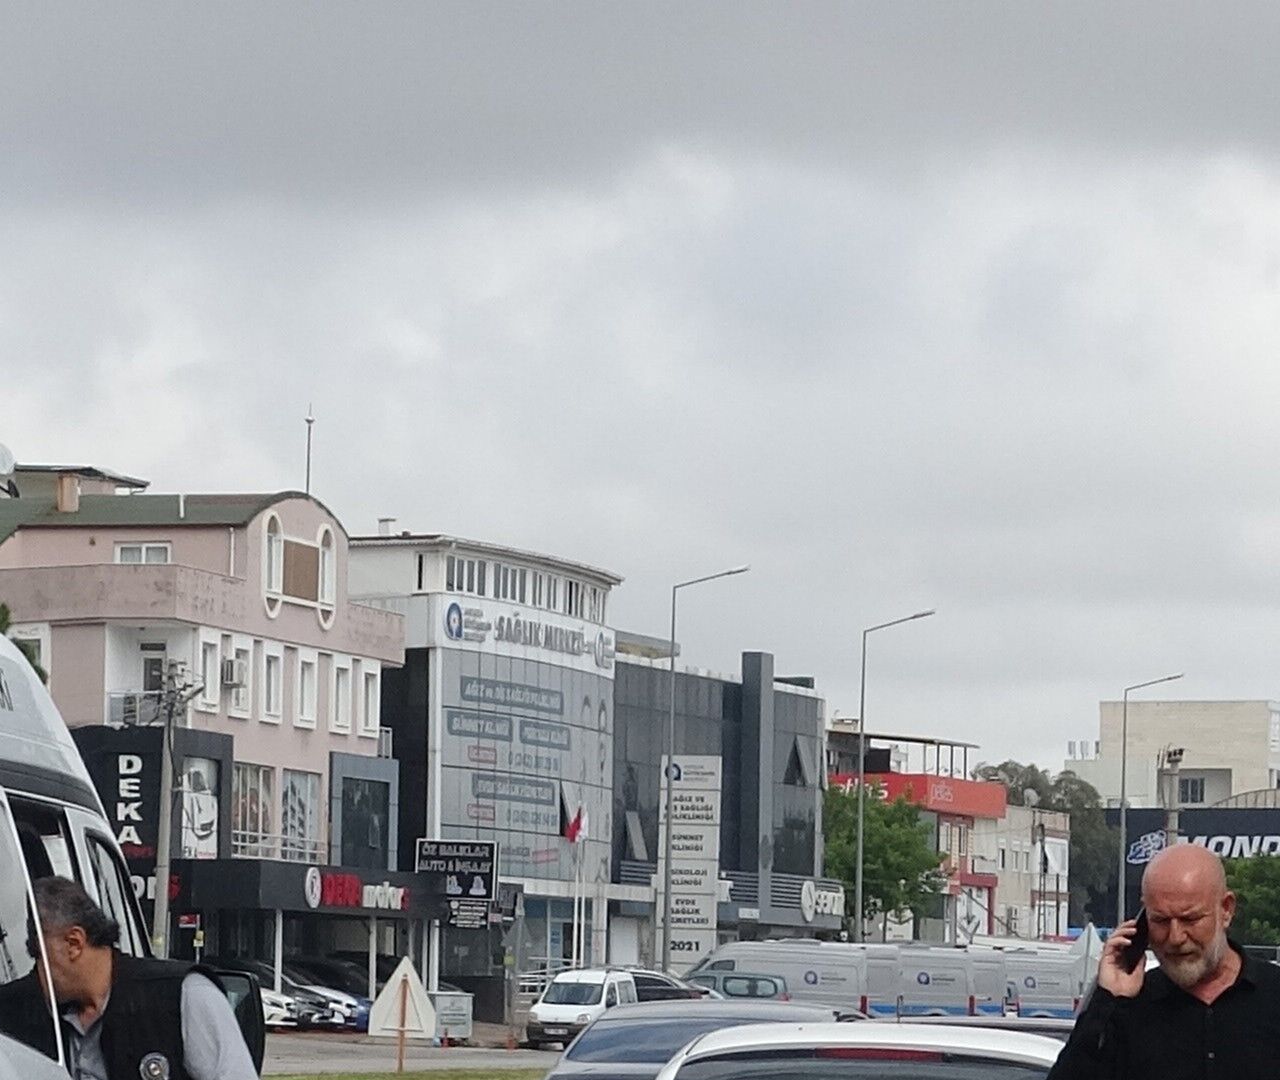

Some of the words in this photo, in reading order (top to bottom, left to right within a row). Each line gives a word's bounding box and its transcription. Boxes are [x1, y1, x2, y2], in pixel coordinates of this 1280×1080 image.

[495, 612, 541, 647] SAĞLIK
[116, 754, 144, 845] DEKA
[422, 842, 437, 856] ÖZ
[670, 868, 708, 876] SİKOLOJİ
[670, 940, 700, 951] 2021
